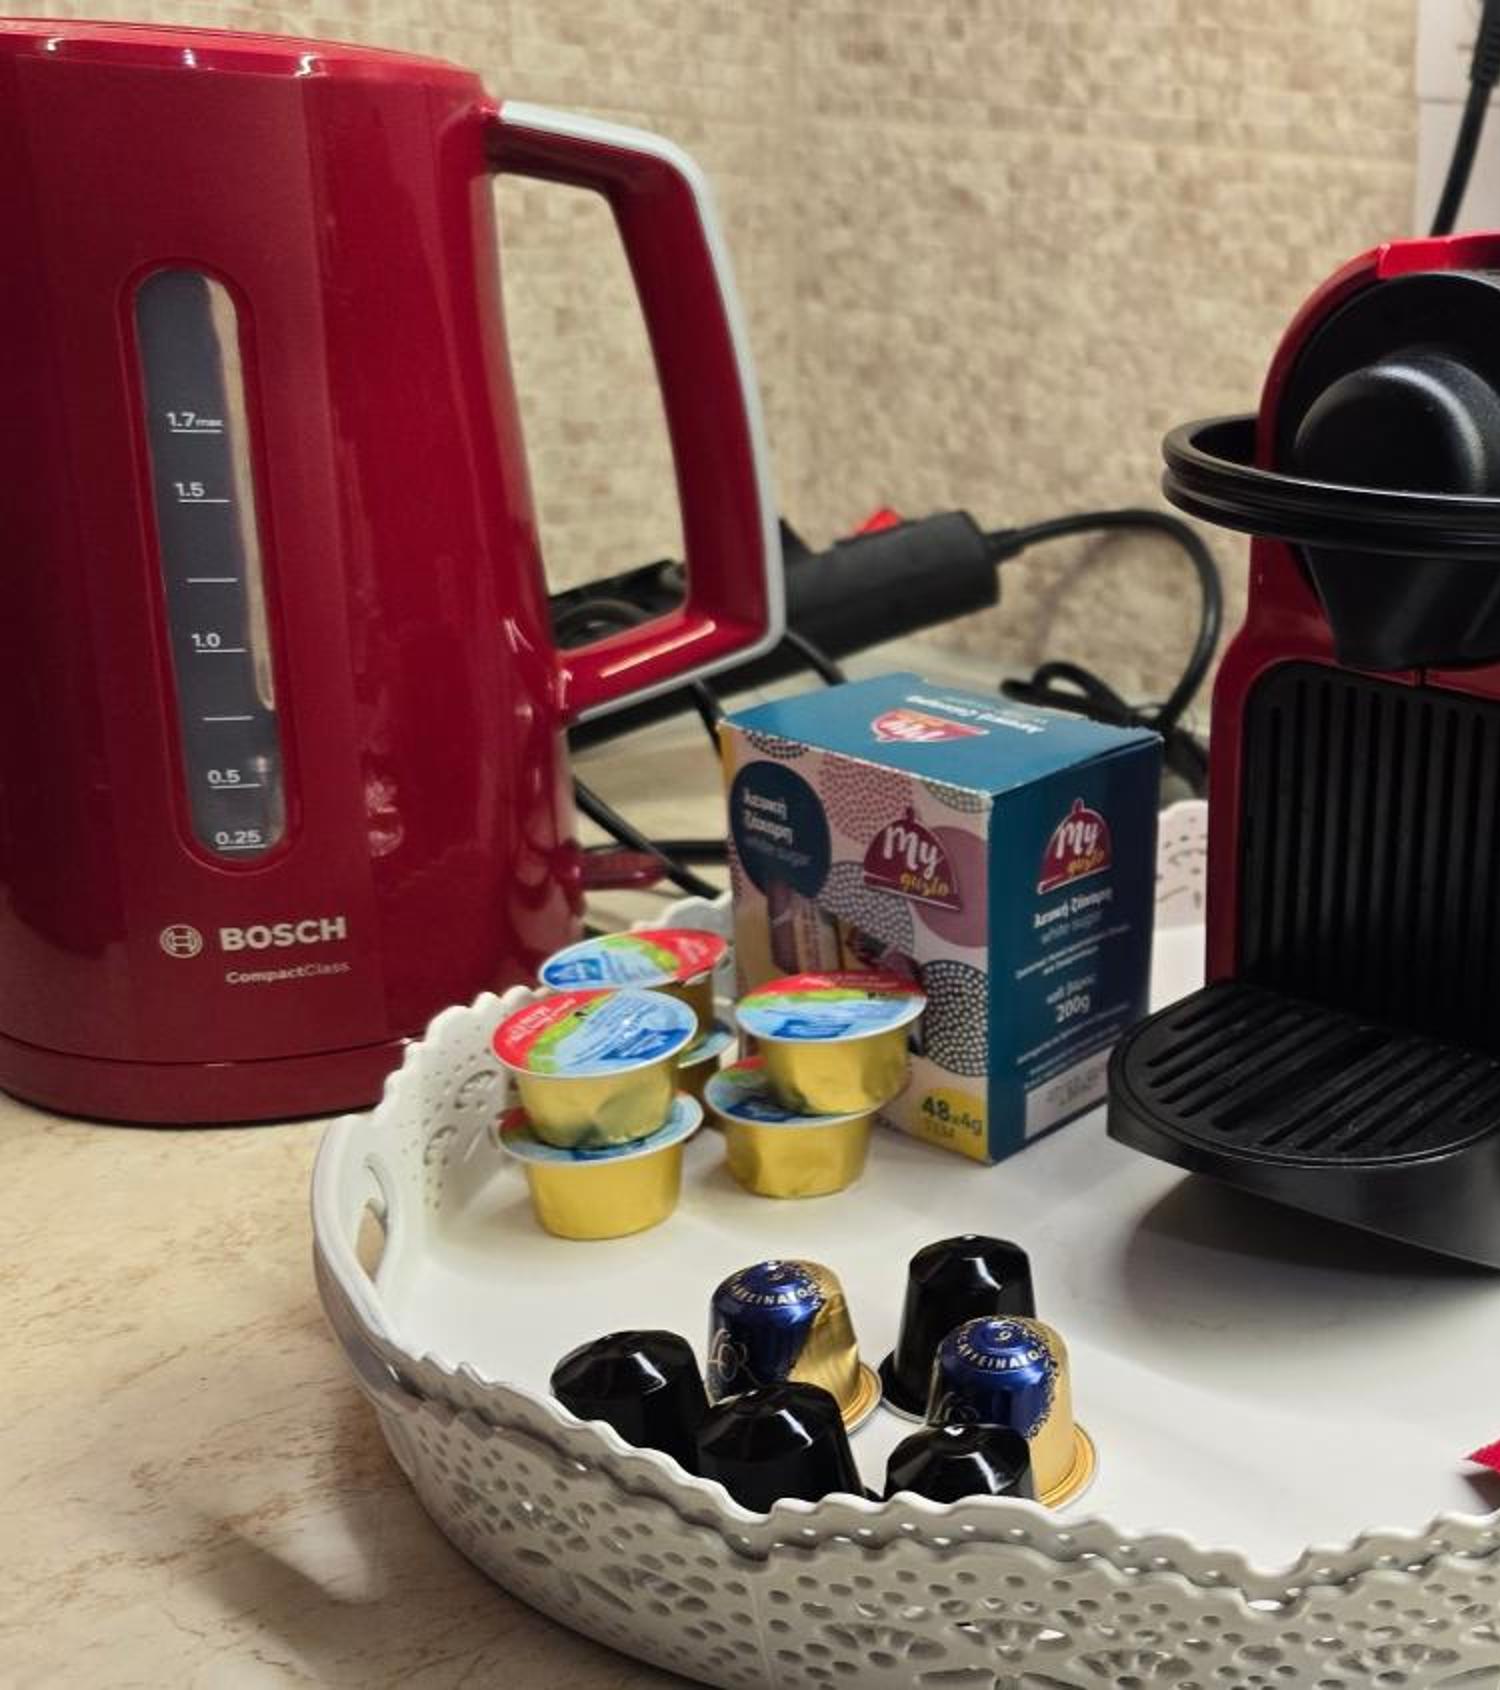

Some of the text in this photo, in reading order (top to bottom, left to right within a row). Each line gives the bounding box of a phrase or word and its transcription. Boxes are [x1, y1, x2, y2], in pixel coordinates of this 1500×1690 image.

[174, 481, 206, 497] 1.5
[191, 632, 221, 648] 1.0
[207, 768, 241, 784] 0.5
[214, 829, 262, 846] 0.25
[1055, 820, 1101, 859] My
[882, 826, 945, 880] My
[218, 915, 348, 951] BOSCH
[1055, 994, 1091, 1024] 200g
